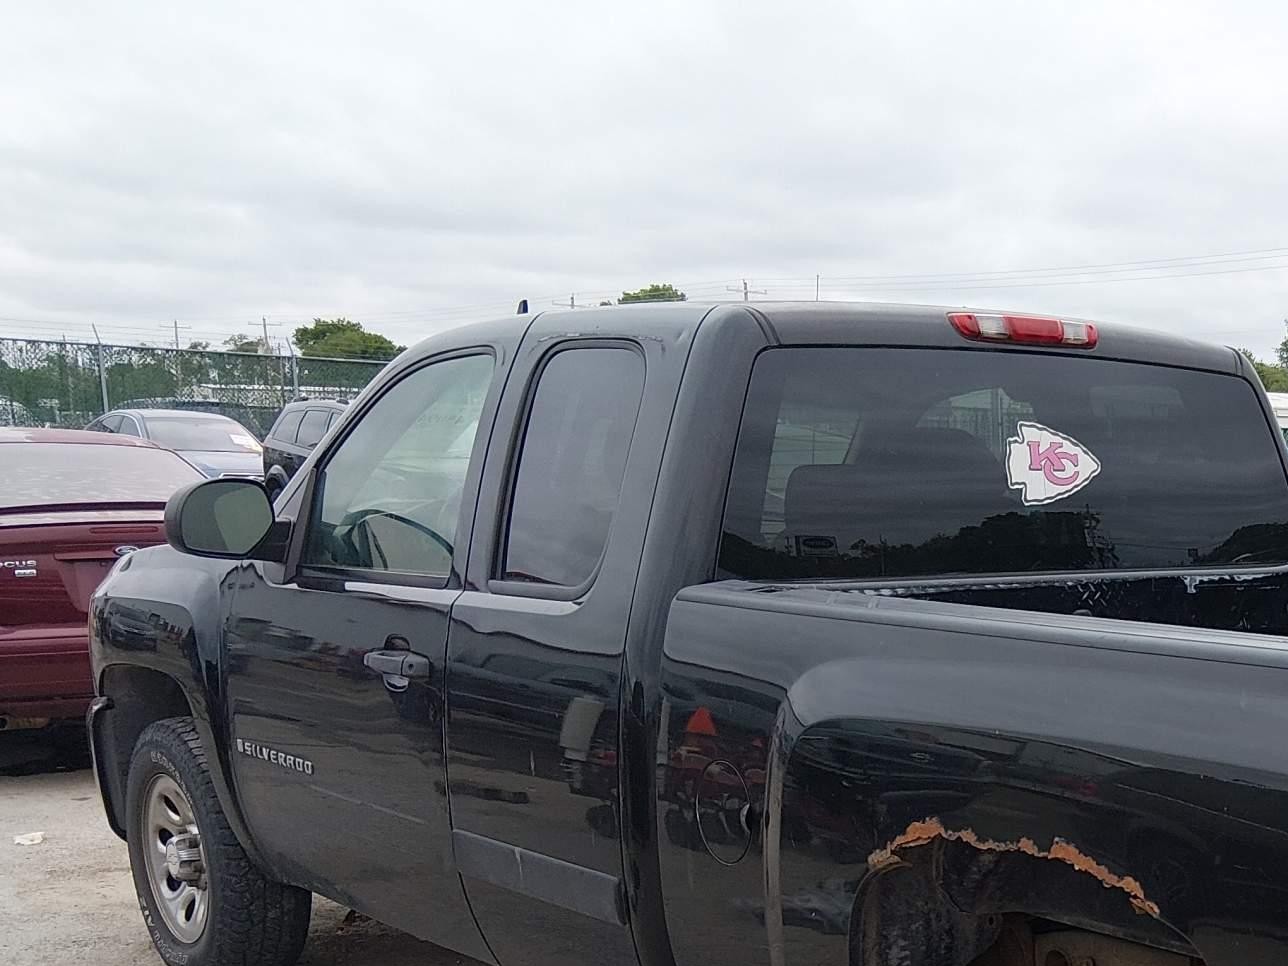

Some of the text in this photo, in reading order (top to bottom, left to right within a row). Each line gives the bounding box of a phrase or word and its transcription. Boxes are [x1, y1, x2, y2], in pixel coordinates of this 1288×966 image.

[1027, 441, 1079, 486] KC
[0, 560, 37, 568] CUS
[244, 742, 312, 775] SILVERADO
